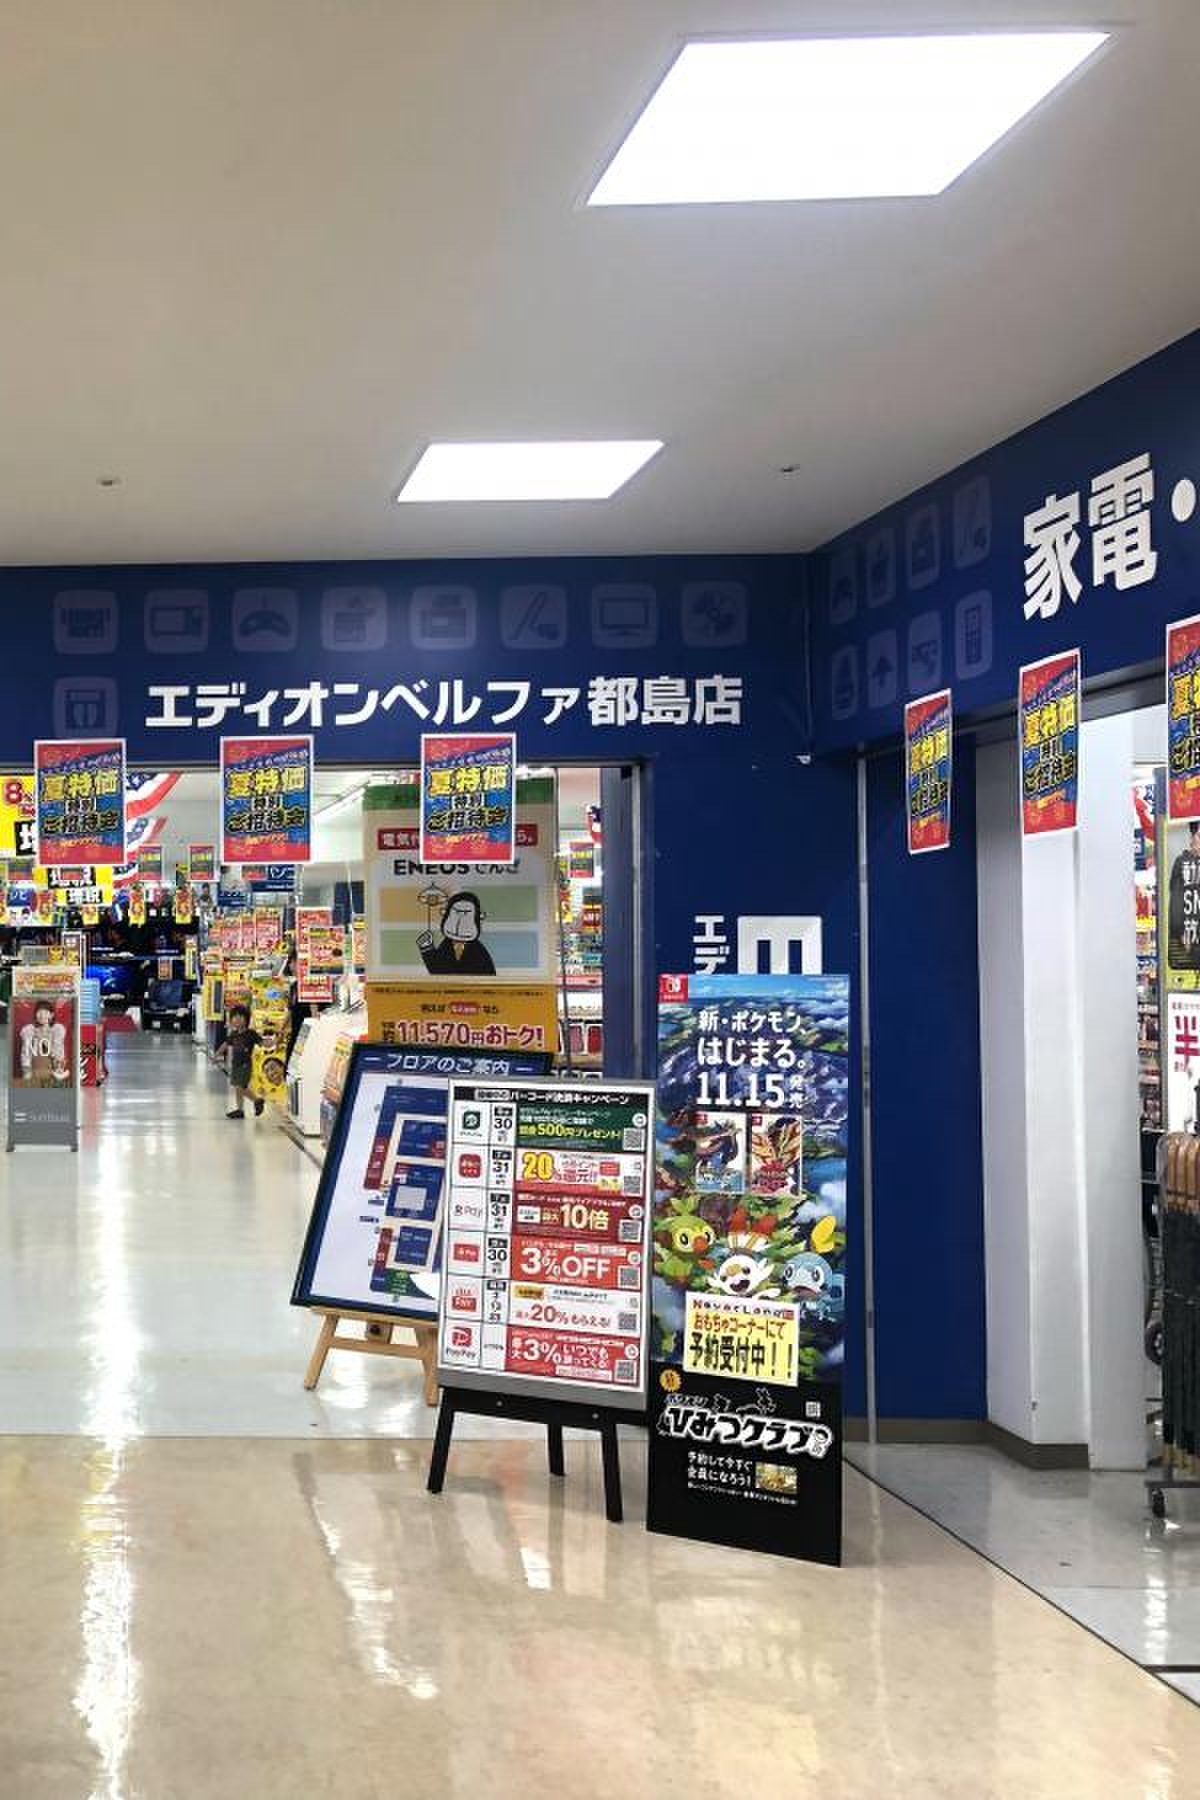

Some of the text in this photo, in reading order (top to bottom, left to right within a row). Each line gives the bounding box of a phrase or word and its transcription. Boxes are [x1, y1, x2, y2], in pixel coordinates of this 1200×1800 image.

[145, 673, 744, 727] エディオンベルファ都島店
[699, 1009, 808, 1035] 新・ポケモン、
[386, 1054, 511, 1076] フロアのご案内
[697, 1037, 806, 1068] はじまる。
[696, 1071, 785, 1109] 11.15
[494, 1118, 513, 1130] 30
[487, 1249, 508, 1262] 30
[667, 1405, 813, 1455] ひみつクラブ
